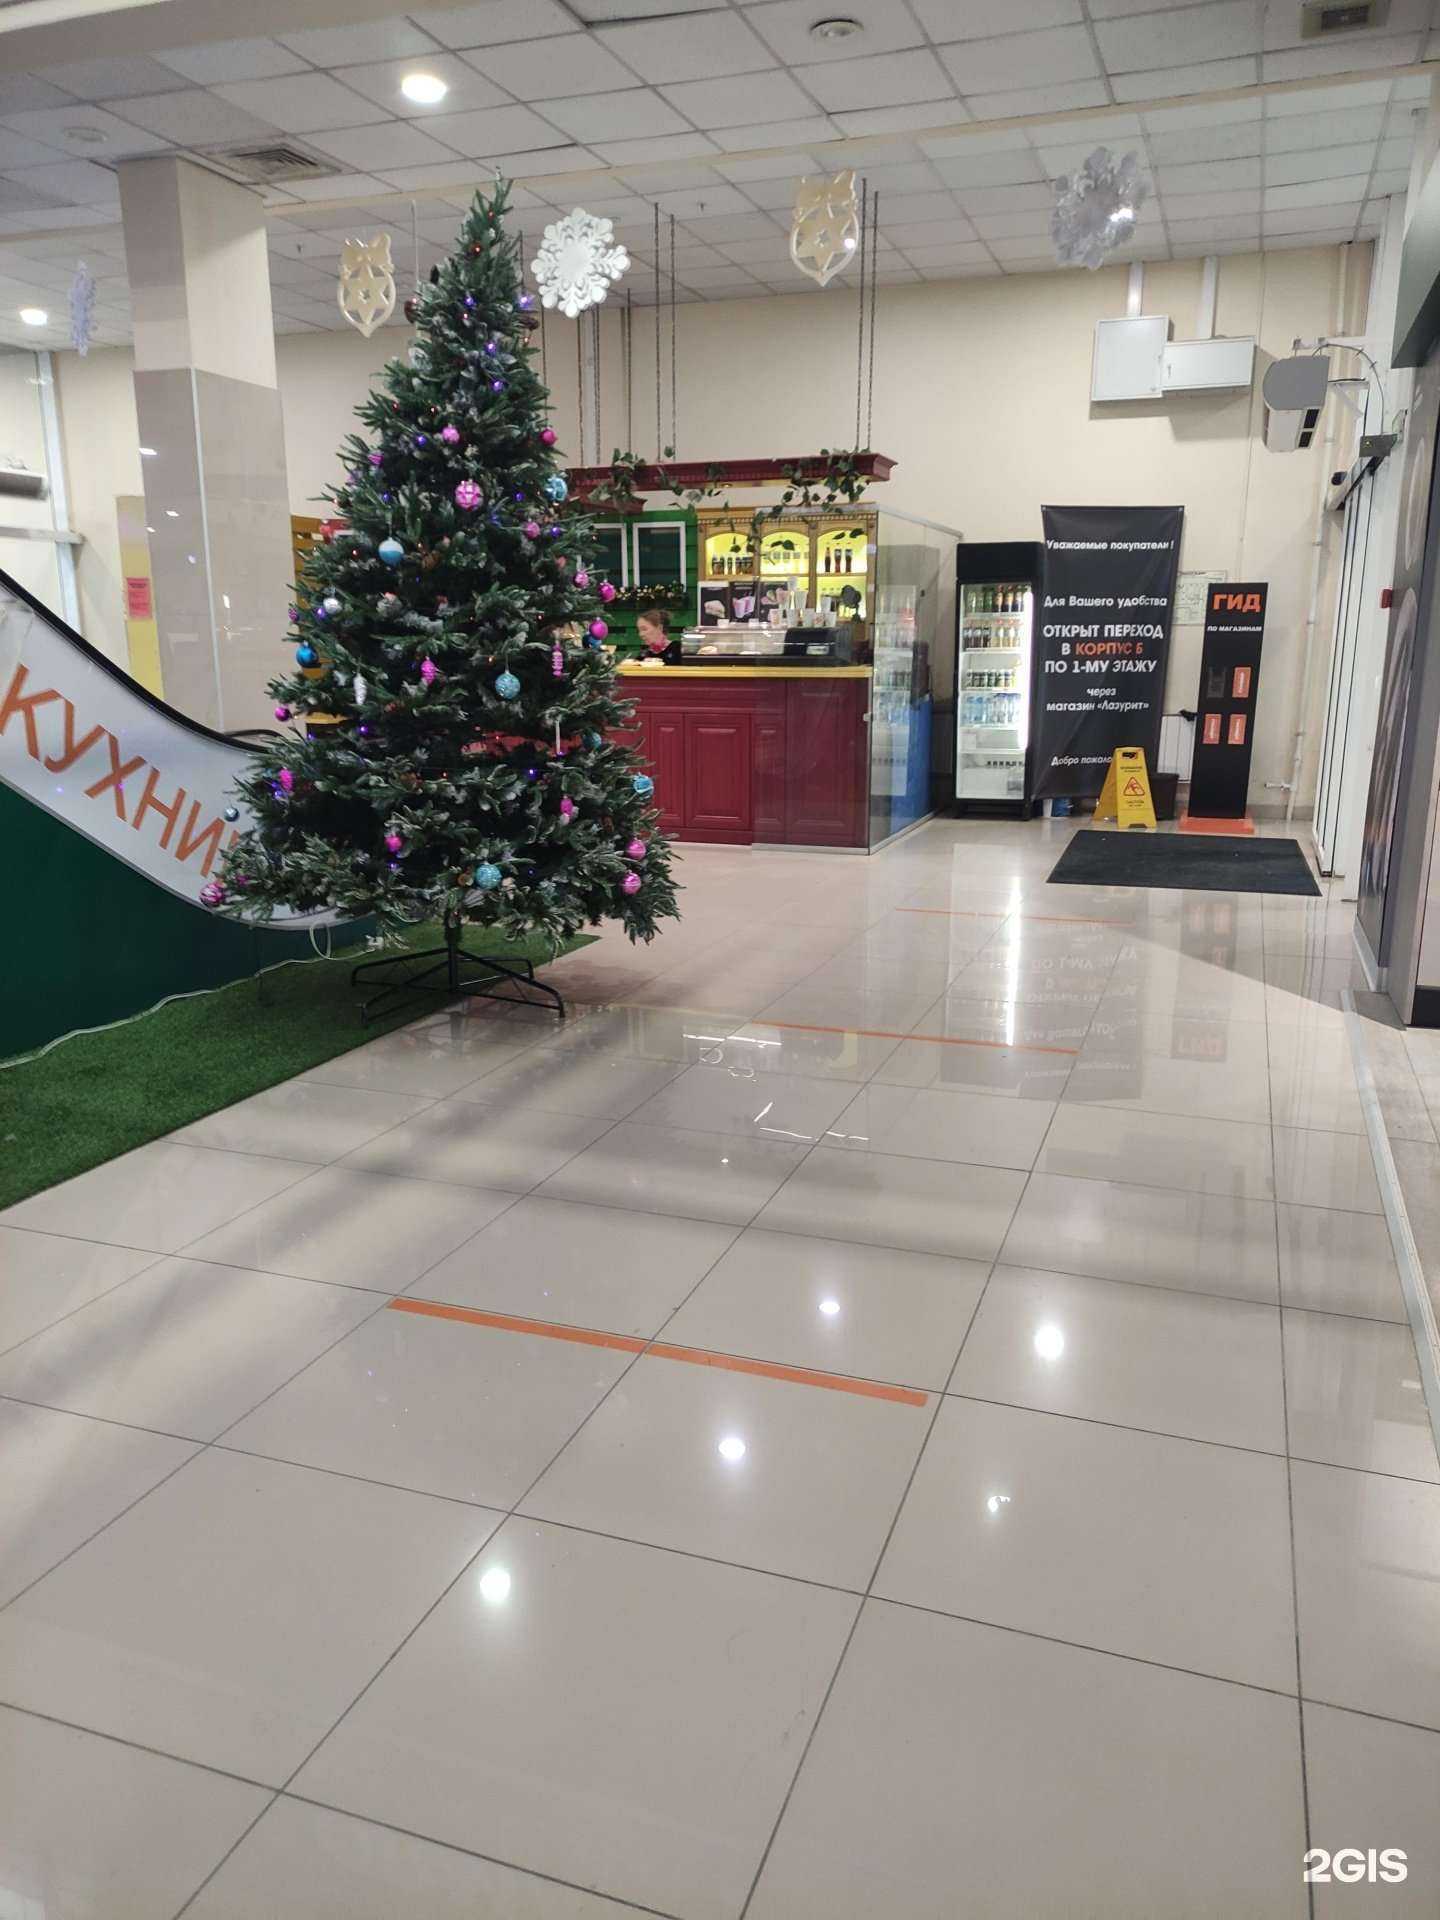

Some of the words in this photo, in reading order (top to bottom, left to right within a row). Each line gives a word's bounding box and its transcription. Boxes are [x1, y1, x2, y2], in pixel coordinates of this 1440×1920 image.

[1046, 539, 1108, 550] Уважаемые
[1044, 595, 1065, 608] Для
[1069, 595, 1114, 606] Вашего
[1117, 595, 1167, 609] удобства
[1213, 593, 1261, 613] ГИД
[1042, 624, 1100, 638] ОТКРЫТ
[1104, 624, 1164, 639] ПЕРЕХОД
[1061, 643, 1071, 656] В
[1075, 642, 1133, 656] КОРПУС
[1044, 660, 1067, 673] ПО
[1071, 660, 1110, 673] 1-МУ
[1112, 660, 1157, 673] ЭТАЖУ
[1086, 688, 1116, 698] через
[1046, 701, 1095, 711] магазин
[1097, 700, 1149, 712] «Лазурит»
[1051, 755, 1079, 767] Добро
[0, 663, 241, 878] КУХНИ
